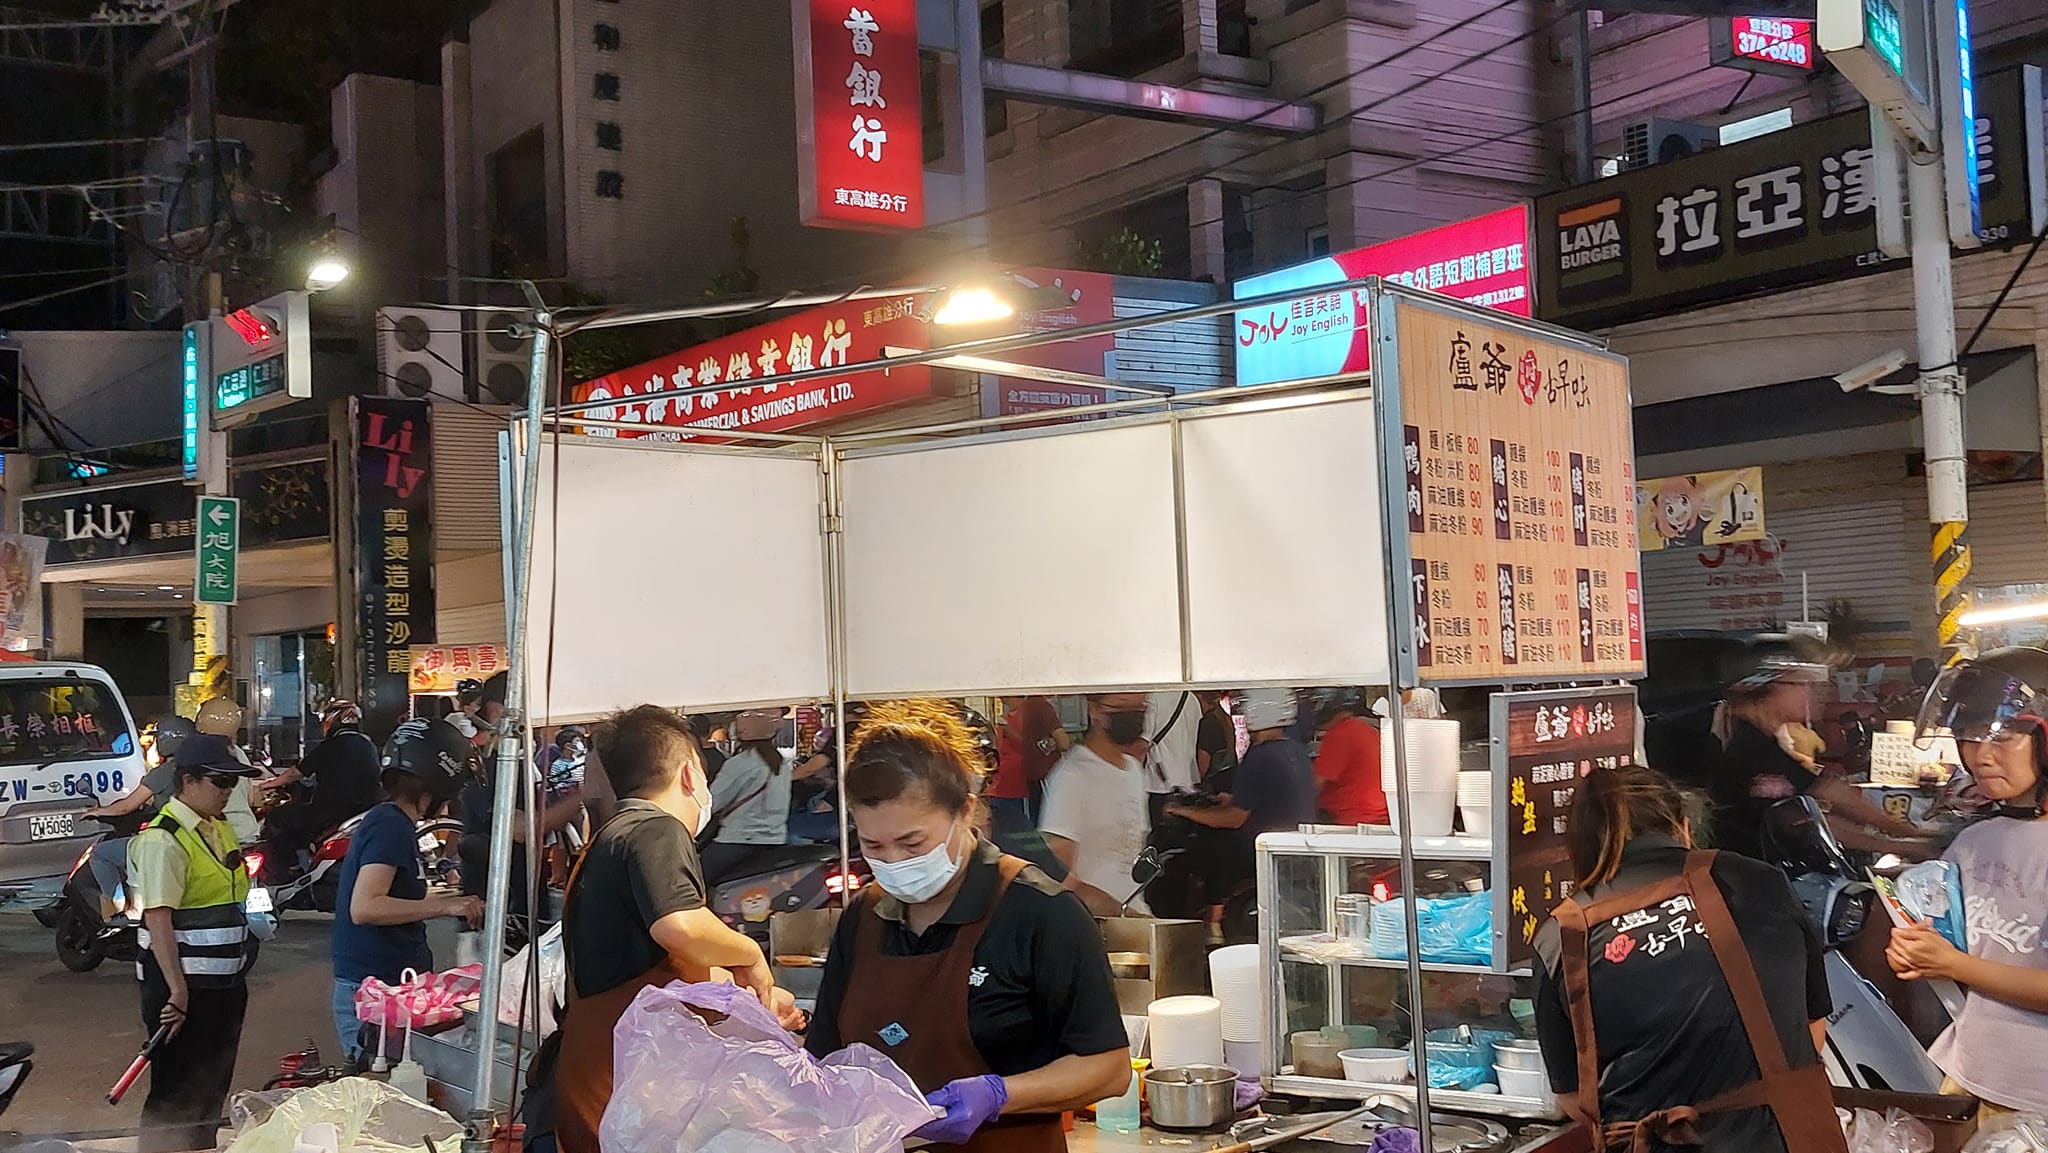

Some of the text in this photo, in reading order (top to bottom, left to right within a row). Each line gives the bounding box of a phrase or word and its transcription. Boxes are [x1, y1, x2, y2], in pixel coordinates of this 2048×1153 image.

[1738, 31, 1807, 65] 374-6248
[834, 188, 908, 213] 東高雄分行
[1559, 217, 1621, 254] LAYA
[1560, 243, 1622, 271] BURGER
[1291, 312, 1349, 337] Joy English
[751, 397, 796, 424] SAVINGS
[796, 387, 829, 412] BANK,
[831, 381, 856, 405] LTD.
[1467, 436, 1479, 455] 80
[1404, 441, 1421, 516] 鴨肉
[1469, 463, 1480, 482] 80
[1492, 453, 1508, 522] 豬心
[1471, 490, 1482, 509] 90
[64, 503, 135, 546] Lily
[1472, 517, 1483, 536] 90
[202, 531, 234, 590] 旭大院
[383, 508, 411, 674] 剪燙造型沙龍
[1413, 573, 1431, 649] 下水
[1477, 617, 1489, 637] 70
[1479, 644, 1490, 663] 70
